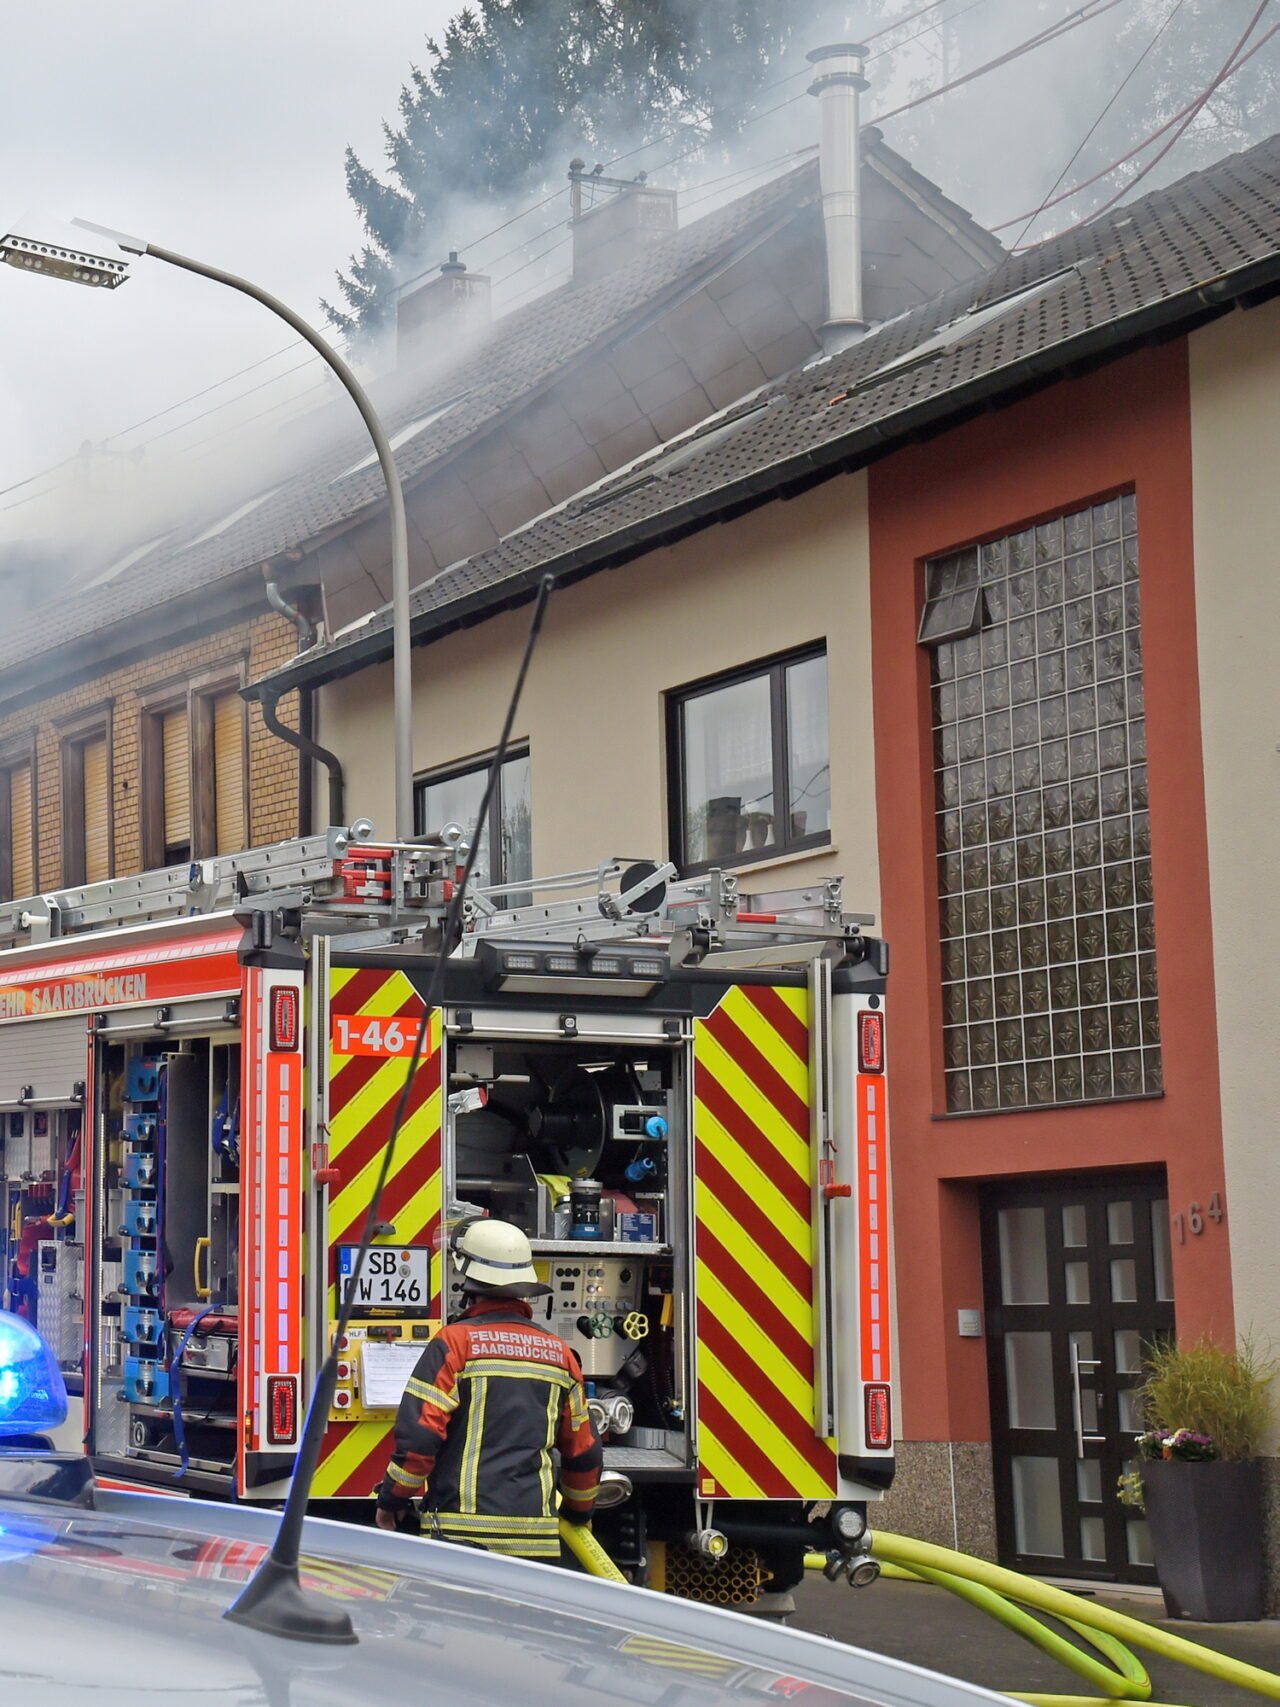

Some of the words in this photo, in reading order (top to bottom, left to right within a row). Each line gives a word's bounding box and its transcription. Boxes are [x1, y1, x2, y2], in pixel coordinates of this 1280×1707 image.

[31, 973, 147, 1014] SAARBRÜCKEN
[1173, 1190, 1222, 1246] 164
[368, 1252, 397, 1275] SB
[380, 1278, 421, 1302] 146
[469, 1330, 563, 1351] FEUERWEHR
[471, 1344, 564, 1363] SAARBRÜCKEN
